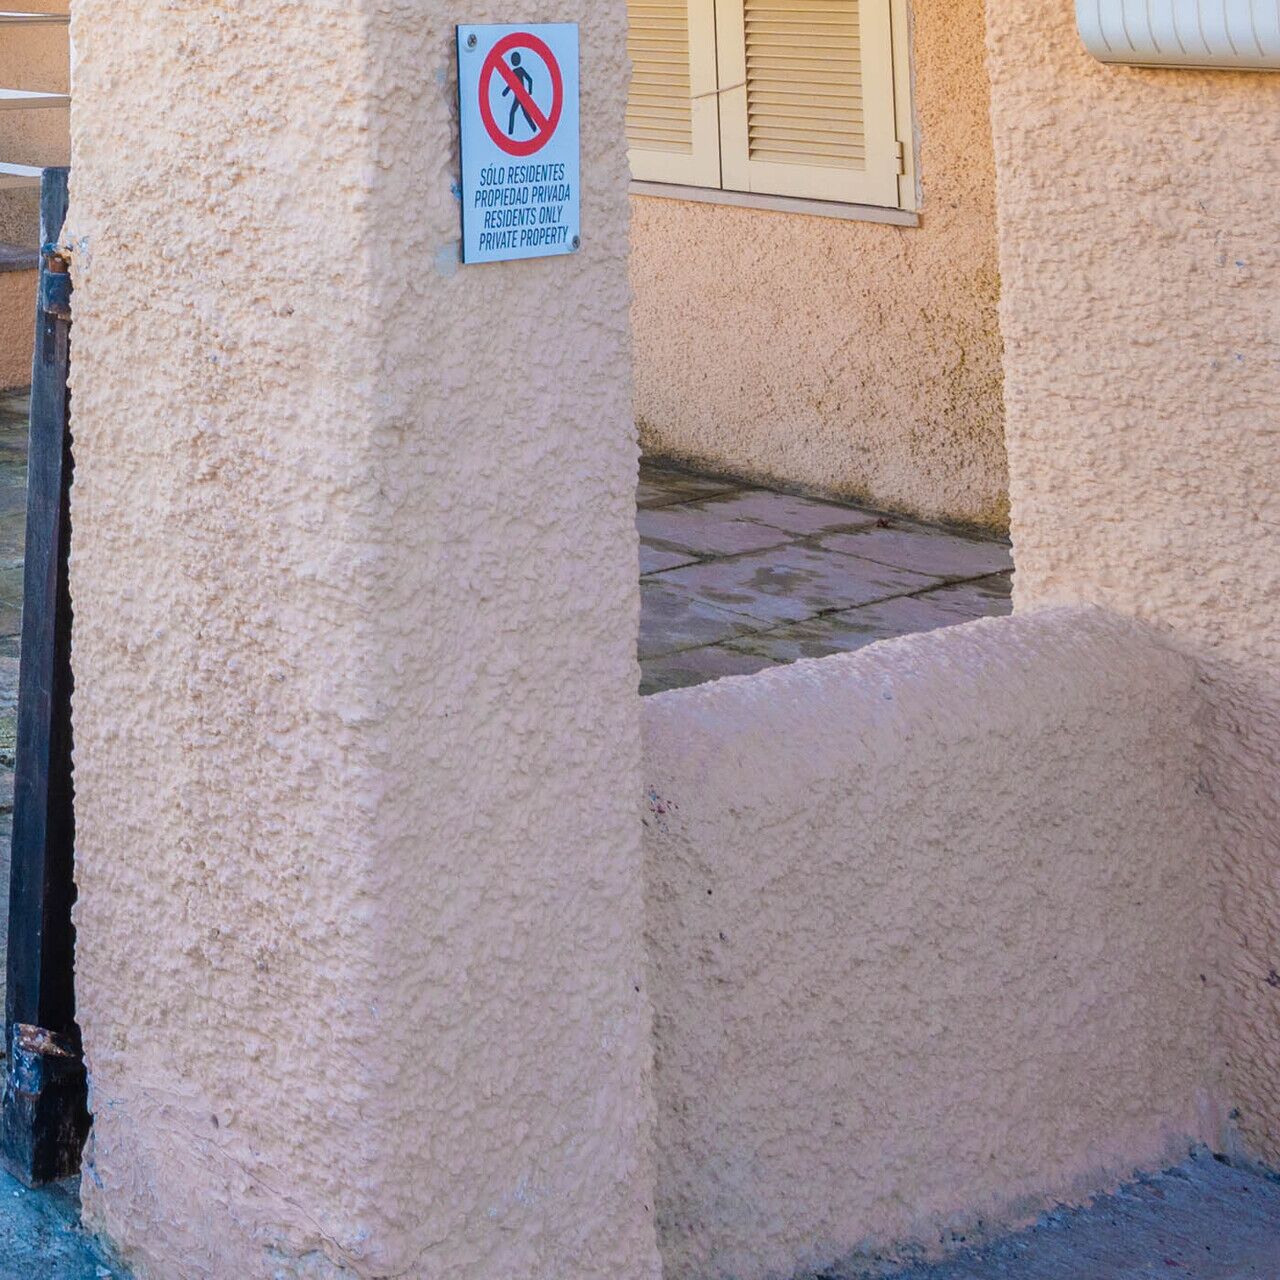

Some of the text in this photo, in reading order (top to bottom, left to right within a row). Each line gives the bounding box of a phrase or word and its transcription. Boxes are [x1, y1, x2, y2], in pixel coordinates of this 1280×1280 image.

[480, 162, 565, 186] SÓLO RESIDENTES
[474, 183, 571, 208] PROPIEDAD PRIVADA
[484, 205, 563, 229] RESIDENTS ONLY
[479, 226, 569, 251] PRIVATE PROPERTY
